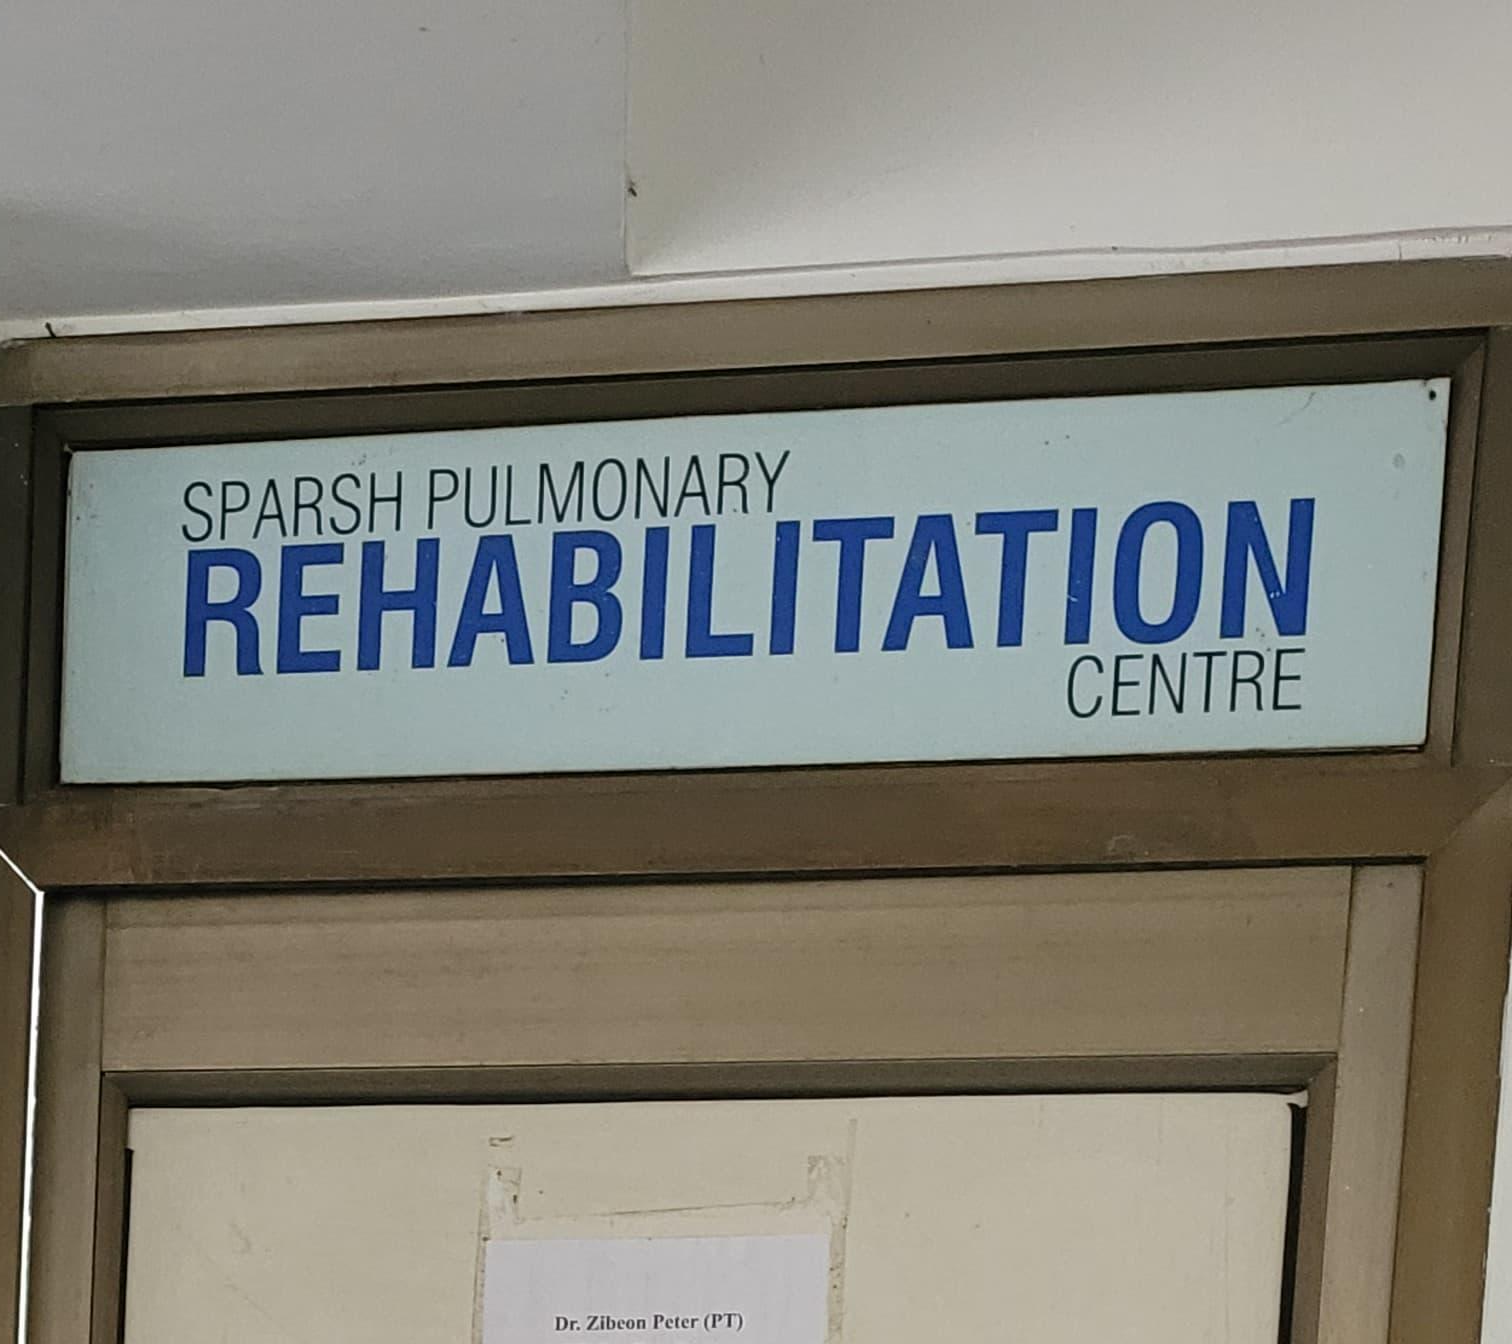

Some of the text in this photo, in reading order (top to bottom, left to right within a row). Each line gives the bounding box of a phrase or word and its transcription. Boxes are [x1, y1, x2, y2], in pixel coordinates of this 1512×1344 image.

[180, 449, 790, 542] SPARSH PULMONARY
[183, 497, 1315, 678] REHABILITATION
[1066, 647, 1304, 718] CENTRE
[555, 1316, 581, 1331] Dr.
[653, 1314, 699, 1330] Peter
[704, 1313, 743, 1332] (PT)
